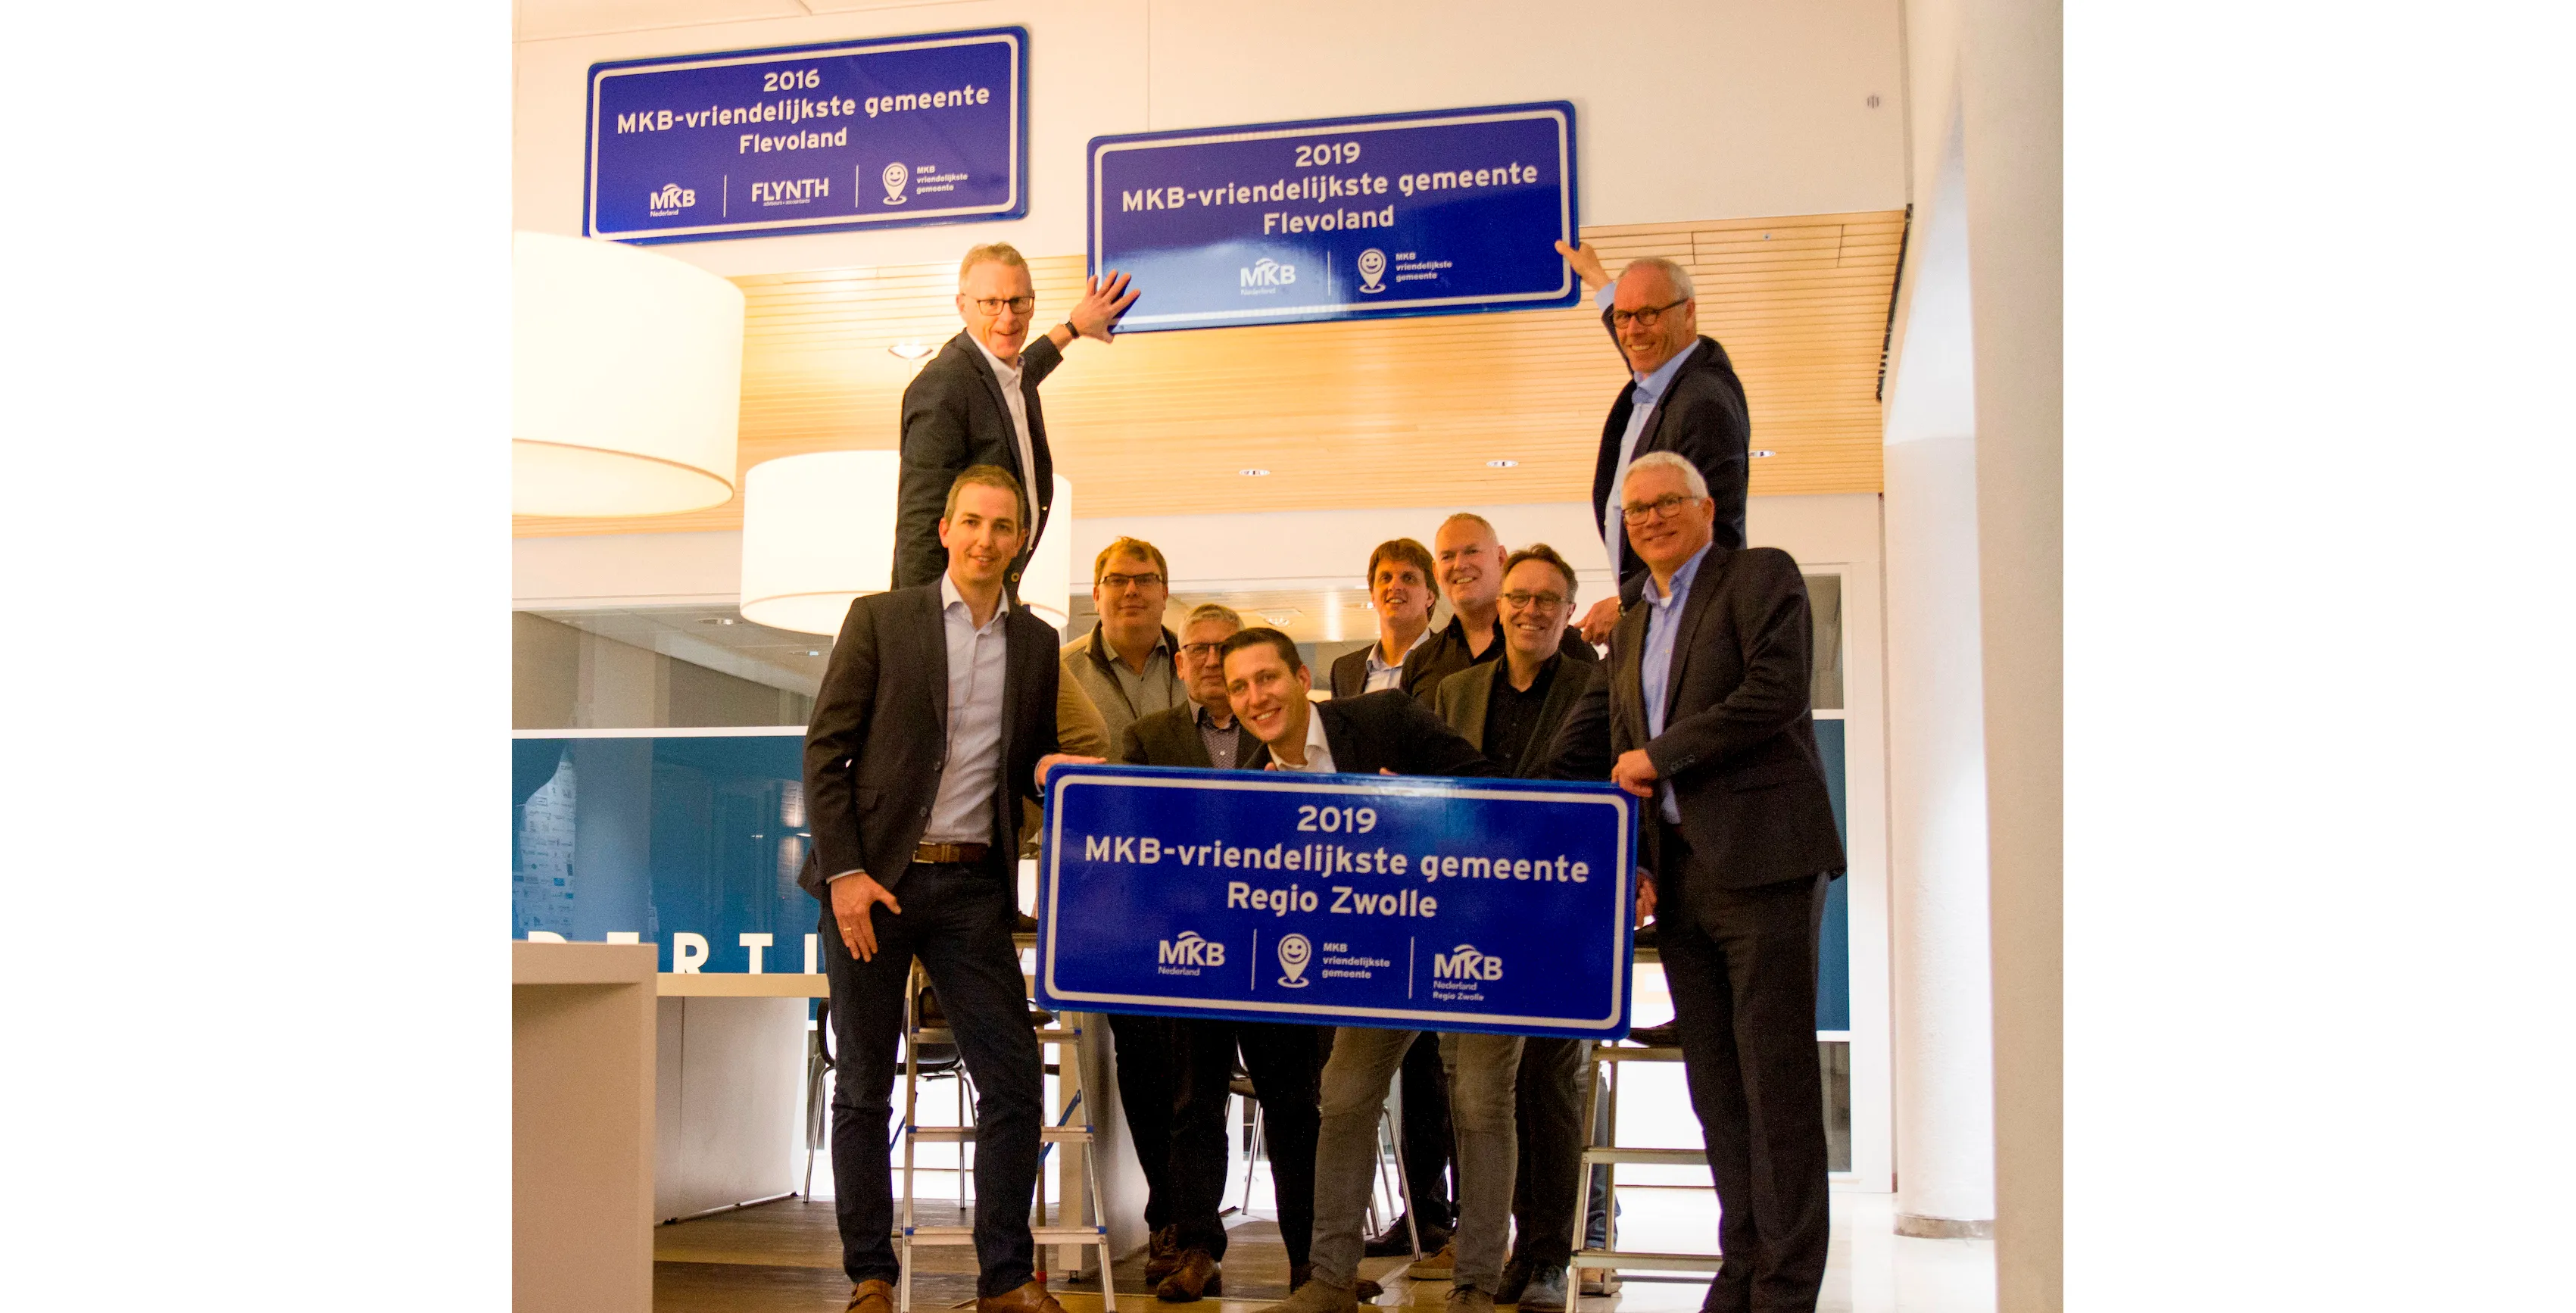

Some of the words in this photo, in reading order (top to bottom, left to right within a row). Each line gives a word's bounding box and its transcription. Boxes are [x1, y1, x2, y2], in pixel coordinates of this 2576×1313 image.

[763, 69, 821, 92] 2016
[616, 95, 856, 134] MKB-vriendelijkste
[864, 84, 990, 118] gemeente
[739, 127, 847, 154] Flevoland
[1295, 142, 1361, 167] 2019
[916, 165, 936, 175] MKB
[916, 173, 968, 183] vriendelijkste
[751, 177, 829, 202] FLYNTH
[916, 184, 954, 195] gemeente
[1122, 175, 1389, 212] MKB-vriendelijkste
[1398, 162, 1538, 195] gemeente
[650, 184, 696, 210] MKB
[650, 209, 679, 217] Nederland
[1263, 205, 1395, 235] Flevoland
[1396, 251, 1416, 261] MKB
[1240, 258, 1296, 287] MKB
[1396, 260, 1453, 271] vriendelijkste
[1396, 272, 1438, 283] gemeente
[1240, 287, 1277, 296] Nederland
[1296, 805, 1377, 834] 2019
[1084, 835, 1408, 878] MKB-vriendelijkste
[1420, 853, 1589, 883] gemeente
[1227, 882, 1318, 918] Regio
[1330, 886, 1438, 918] Zwolle
[1158, 931, 1226, 967] MKB
[1322, 942, 1349, 953] MKB
[1321, 956, 1391, 968] vriendelijkste
[1433, 944, 1504, 981] MKB
[1158, 966, 1201, 976] Nederland
[1321, 969, 1372, 979] gemeente
[1433, 980, 1478, 990] Nederland
[1433, 990, 1456, 1002] Regio
[1457, 992, 1485, 1001] Zwolle
